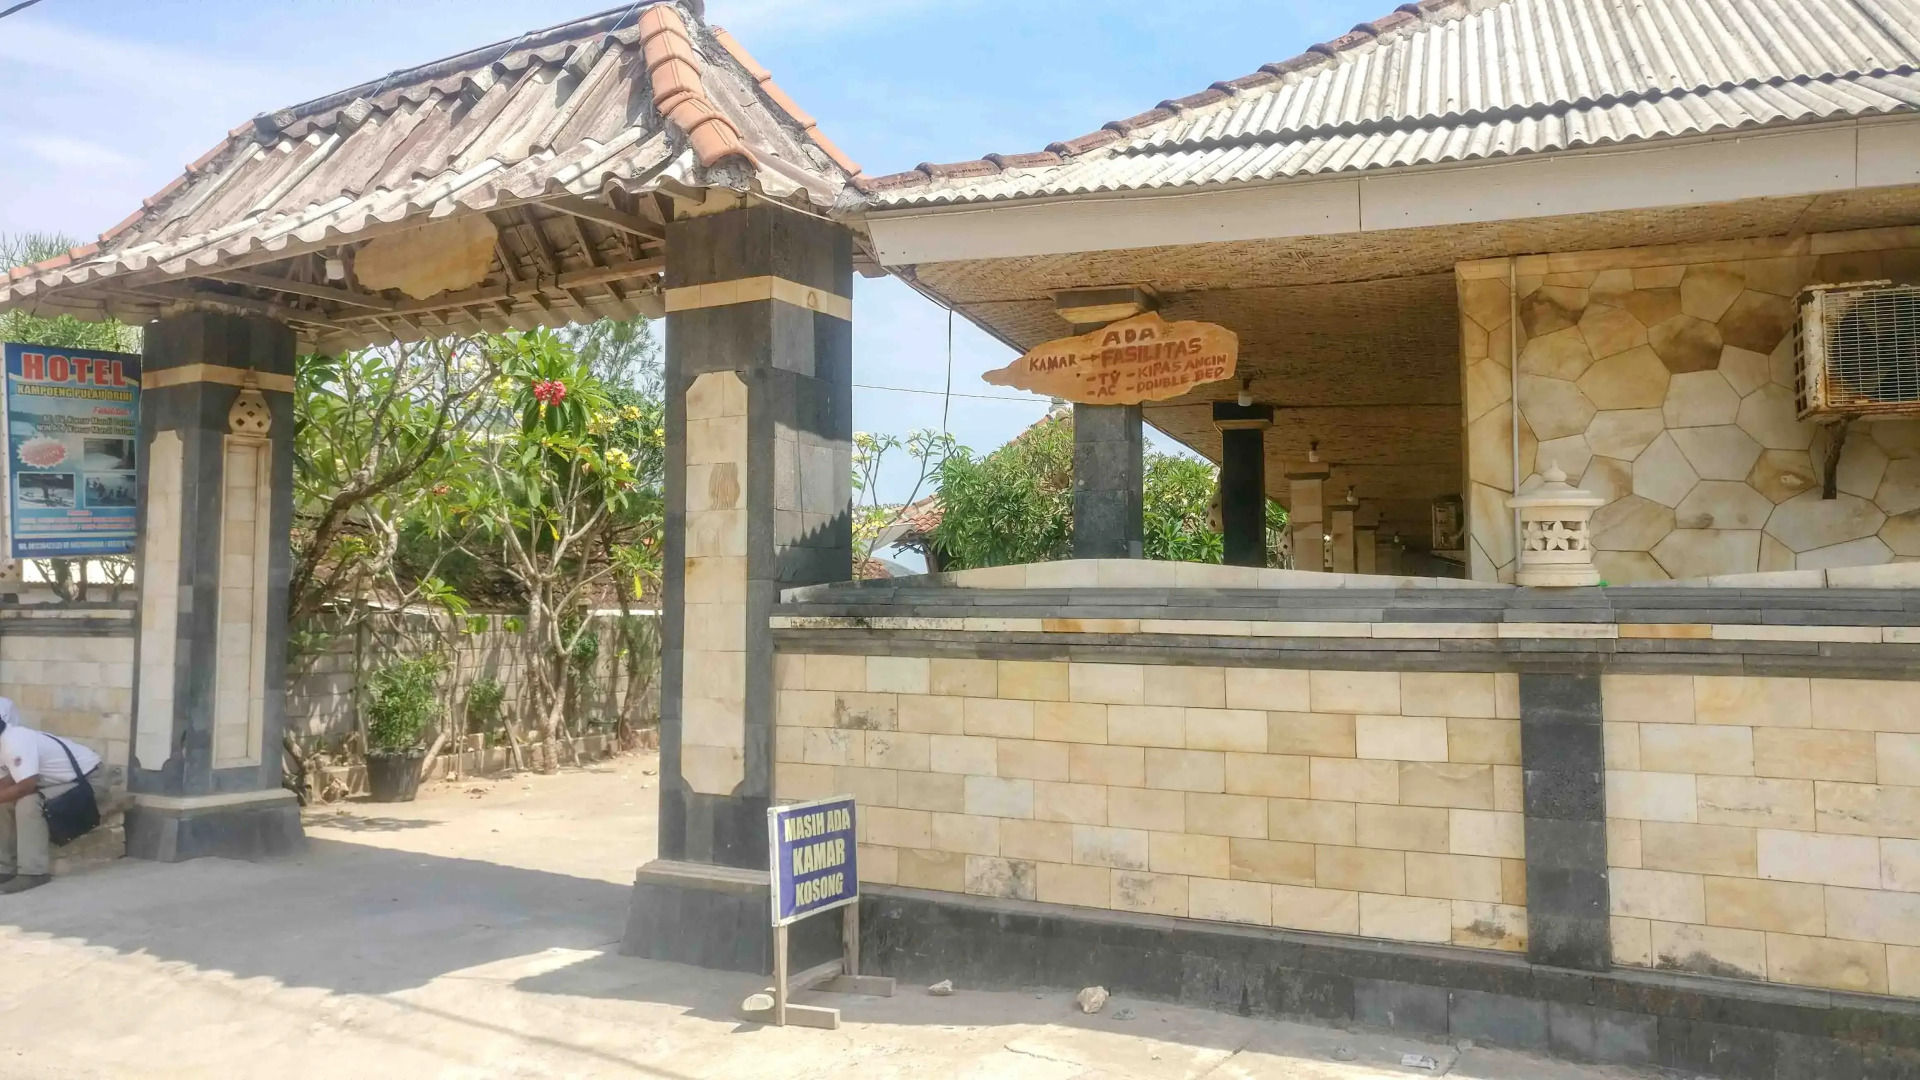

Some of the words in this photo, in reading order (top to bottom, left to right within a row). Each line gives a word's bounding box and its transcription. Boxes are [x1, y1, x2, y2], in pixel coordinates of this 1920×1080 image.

[1102, 328, 1155, 346] ADA
[21, 352, 128, 386] HOTEL
[1029, 356, 1077, 373] KAMAR
[1101, 337, 1202, 368] FASILITAS
[1183, 354, 1226, 372] ANGIN
[1194, 366, 1225, 382] BED
[17, 384, 73, 398] KAMPOENG
[74, 388, 105, 400] PULAU
[784, 812, 825, 842] MASIH
[826, 808, 851, 833] ADA
[792, 838, 846, 877] KAMAR
[795, 872, 844, 907] KOSONG
